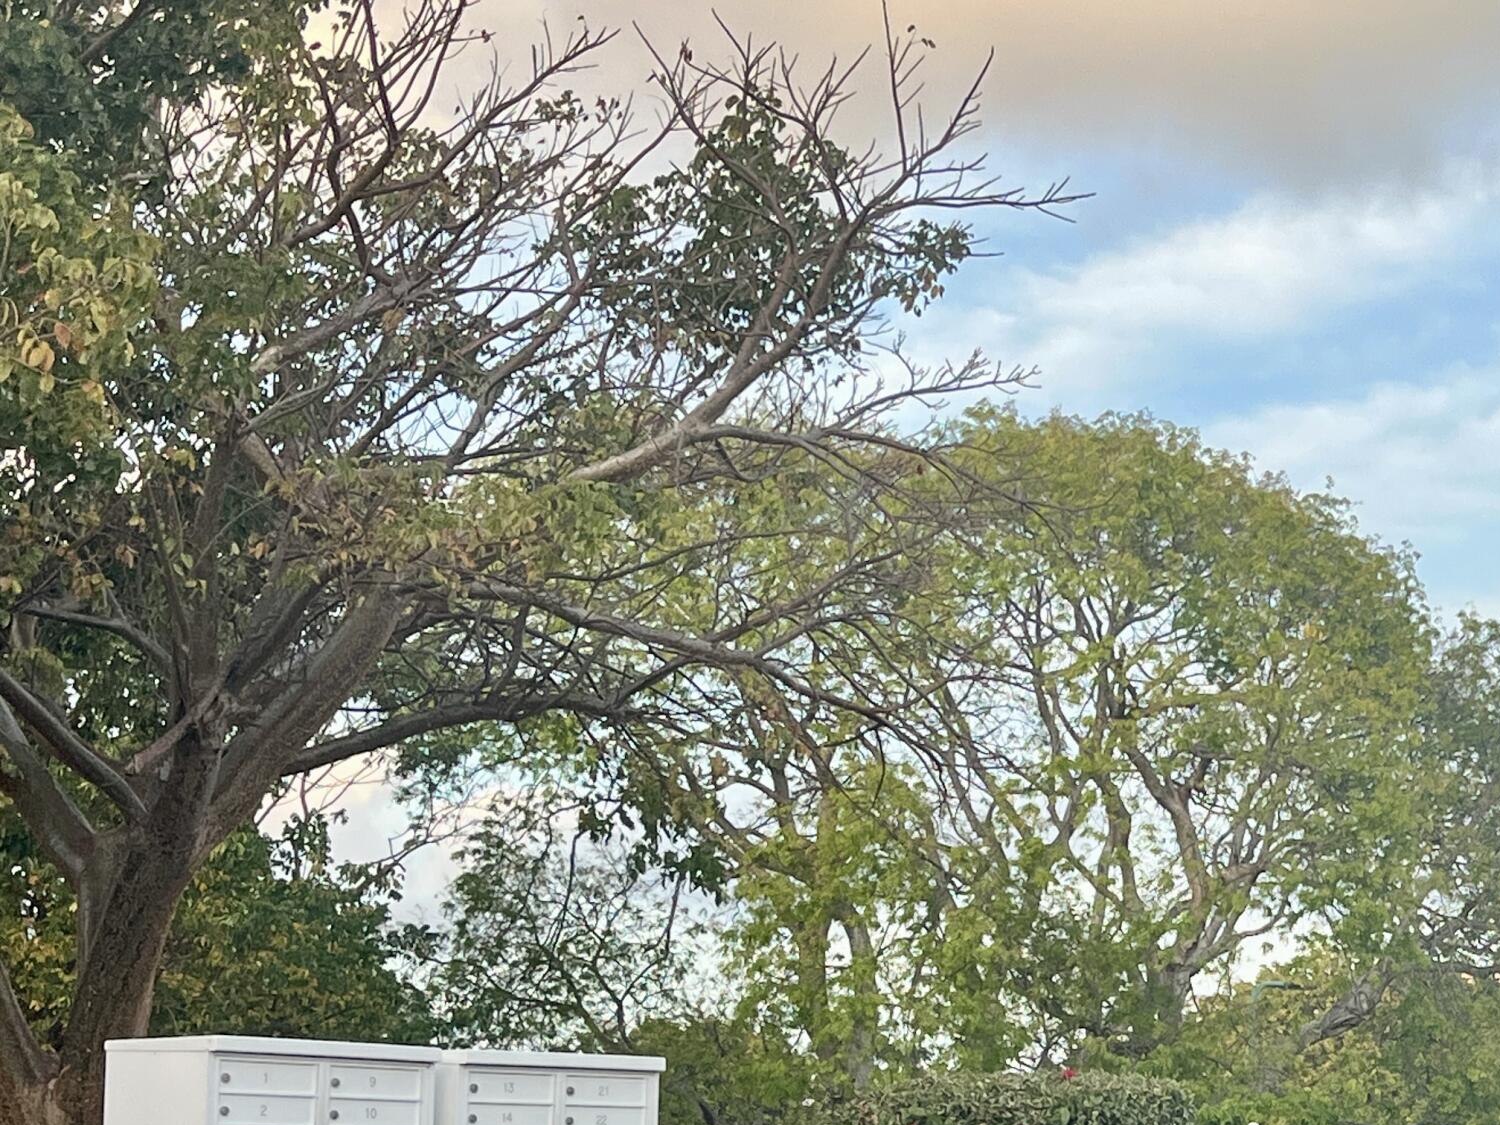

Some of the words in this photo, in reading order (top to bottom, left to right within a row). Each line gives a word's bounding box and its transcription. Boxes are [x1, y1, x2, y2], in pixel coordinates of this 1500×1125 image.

[263, 1072, 268, 1083] 1
[369, 1077, 376, 1088] 9
[503, 1082, 515, 1093] 13
[598, 1086, 609, 1096] 21
[259, 1105, 268, 1117] 2
[365, 1108, 377, 1119] 10
[502, 1112, 513, 1122] 14
[596, 1115, 608, 1125] 22
